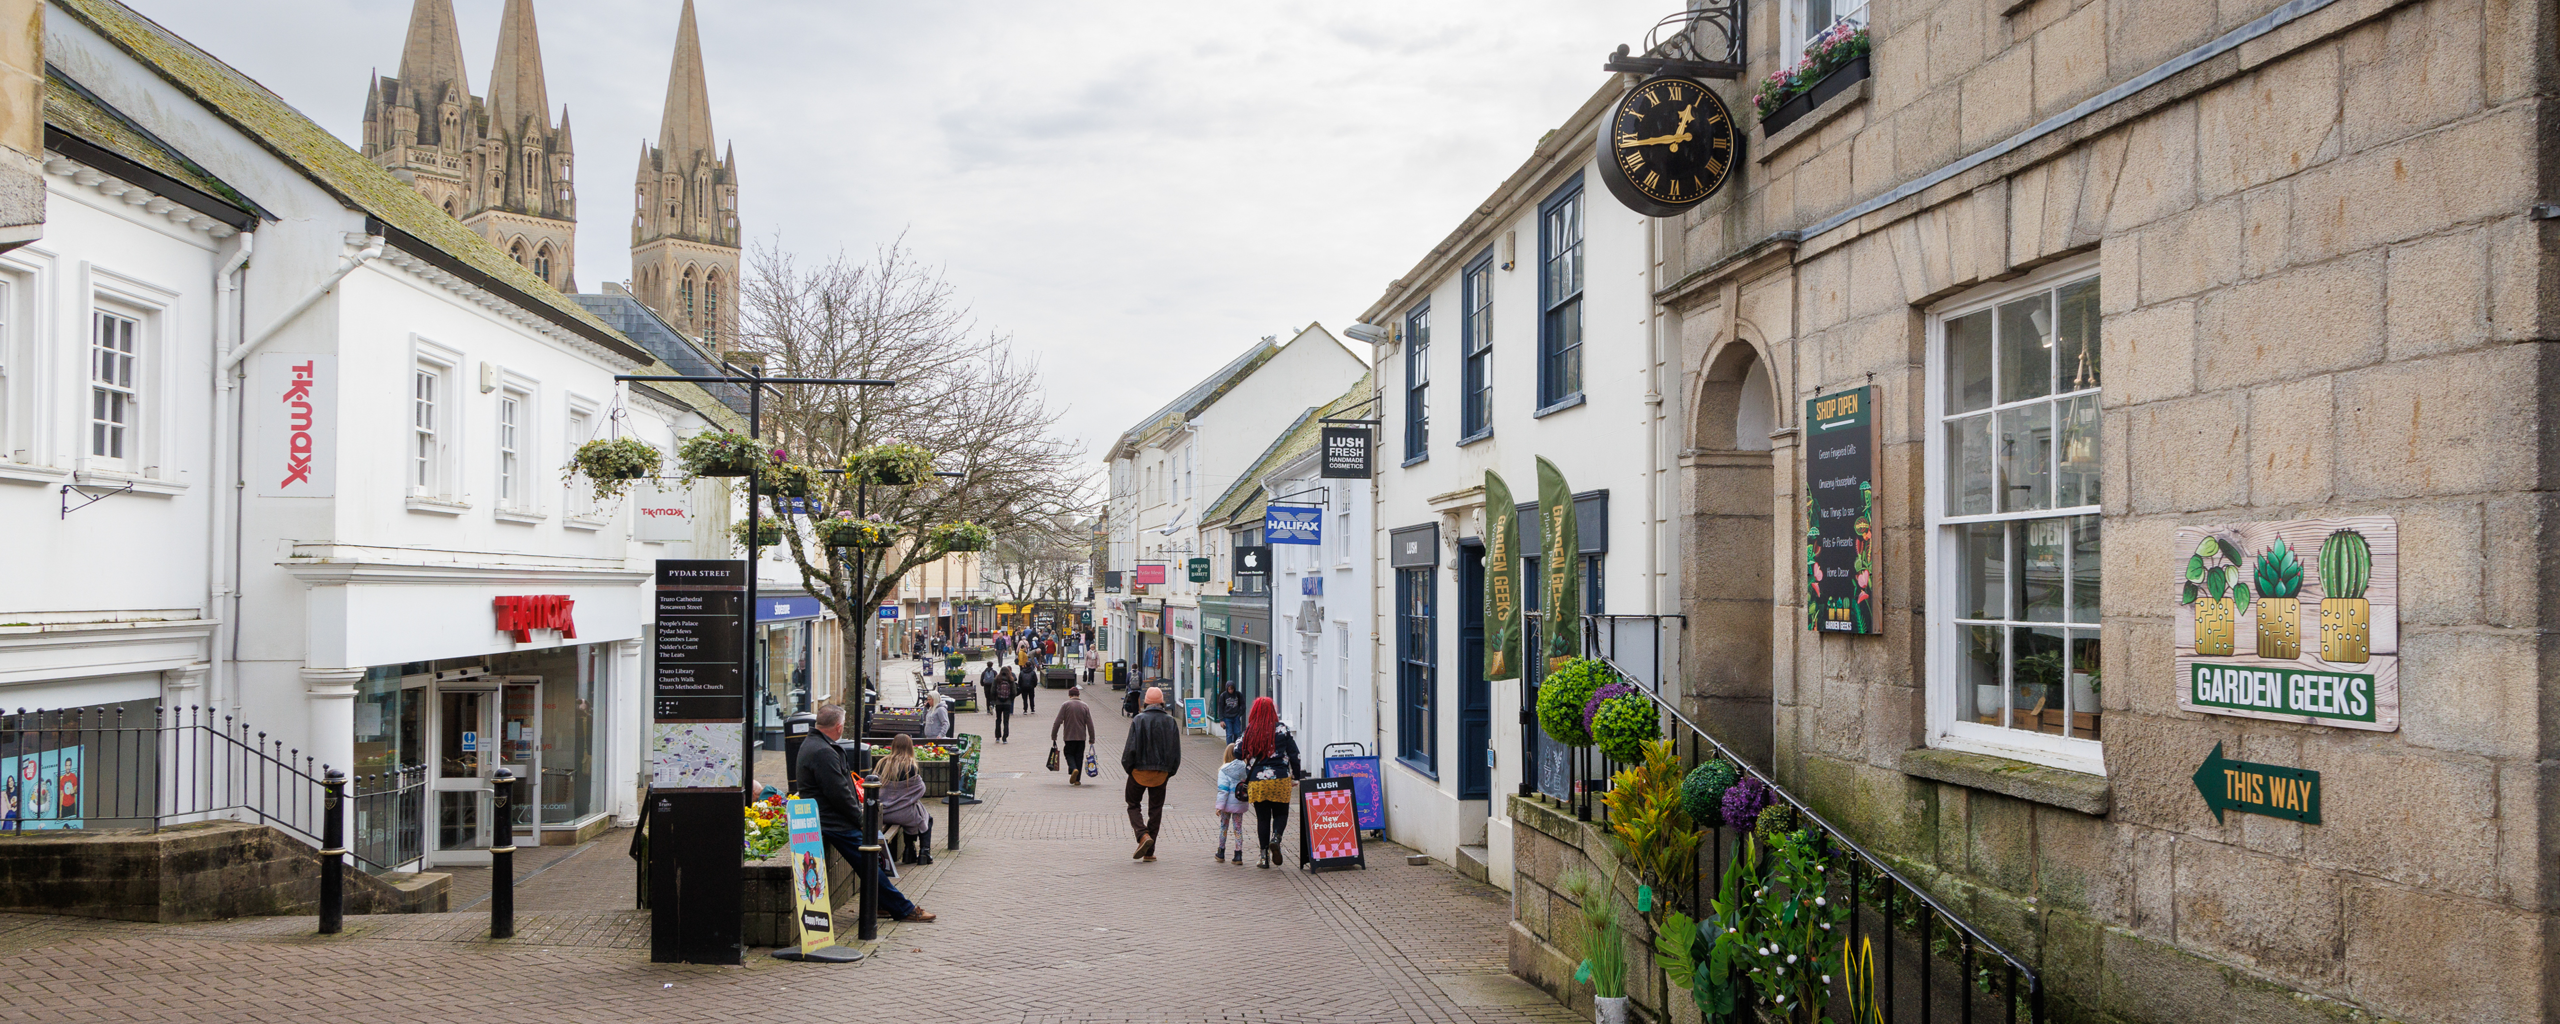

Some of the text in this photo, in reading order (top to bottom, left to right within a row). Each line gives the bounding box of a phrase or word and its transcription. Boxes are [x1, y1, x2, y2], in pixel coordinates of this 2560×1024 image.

[1816, 394, 1858, 421] SHOP OPEN
[1329, 437, 1364, 448] LUSH
[1329, 448, 1364, 457] FRESH
[1818, 449, 1830, 460] Green
[1820, 507, 1855, 519] Nice Things to see
[1268, 520, 1319, 531] HALIFAX
[1543, 512, 1551, 543] Plants
[2029, 522, 2063, 547] OPEN
[1822, 537, 1832, 548] Pots
[1836, 536, 1854, 547] Presents
[1493, 515, 1510, 621] GARDEN GEEKS
[1826, 567, 1849, 577] Home Decor
[1825, 620, 1852, 631] GARDEN GEEKS
[2197, 666, 2368, 717] GARDEN GEEKS
[1316, 781, 1338, 790] LUSH
[2223, 769, 2312, 813] THIS WAY
[1322, 815, 1339, 823] New
[1314, 820, 1349, 830] Products
